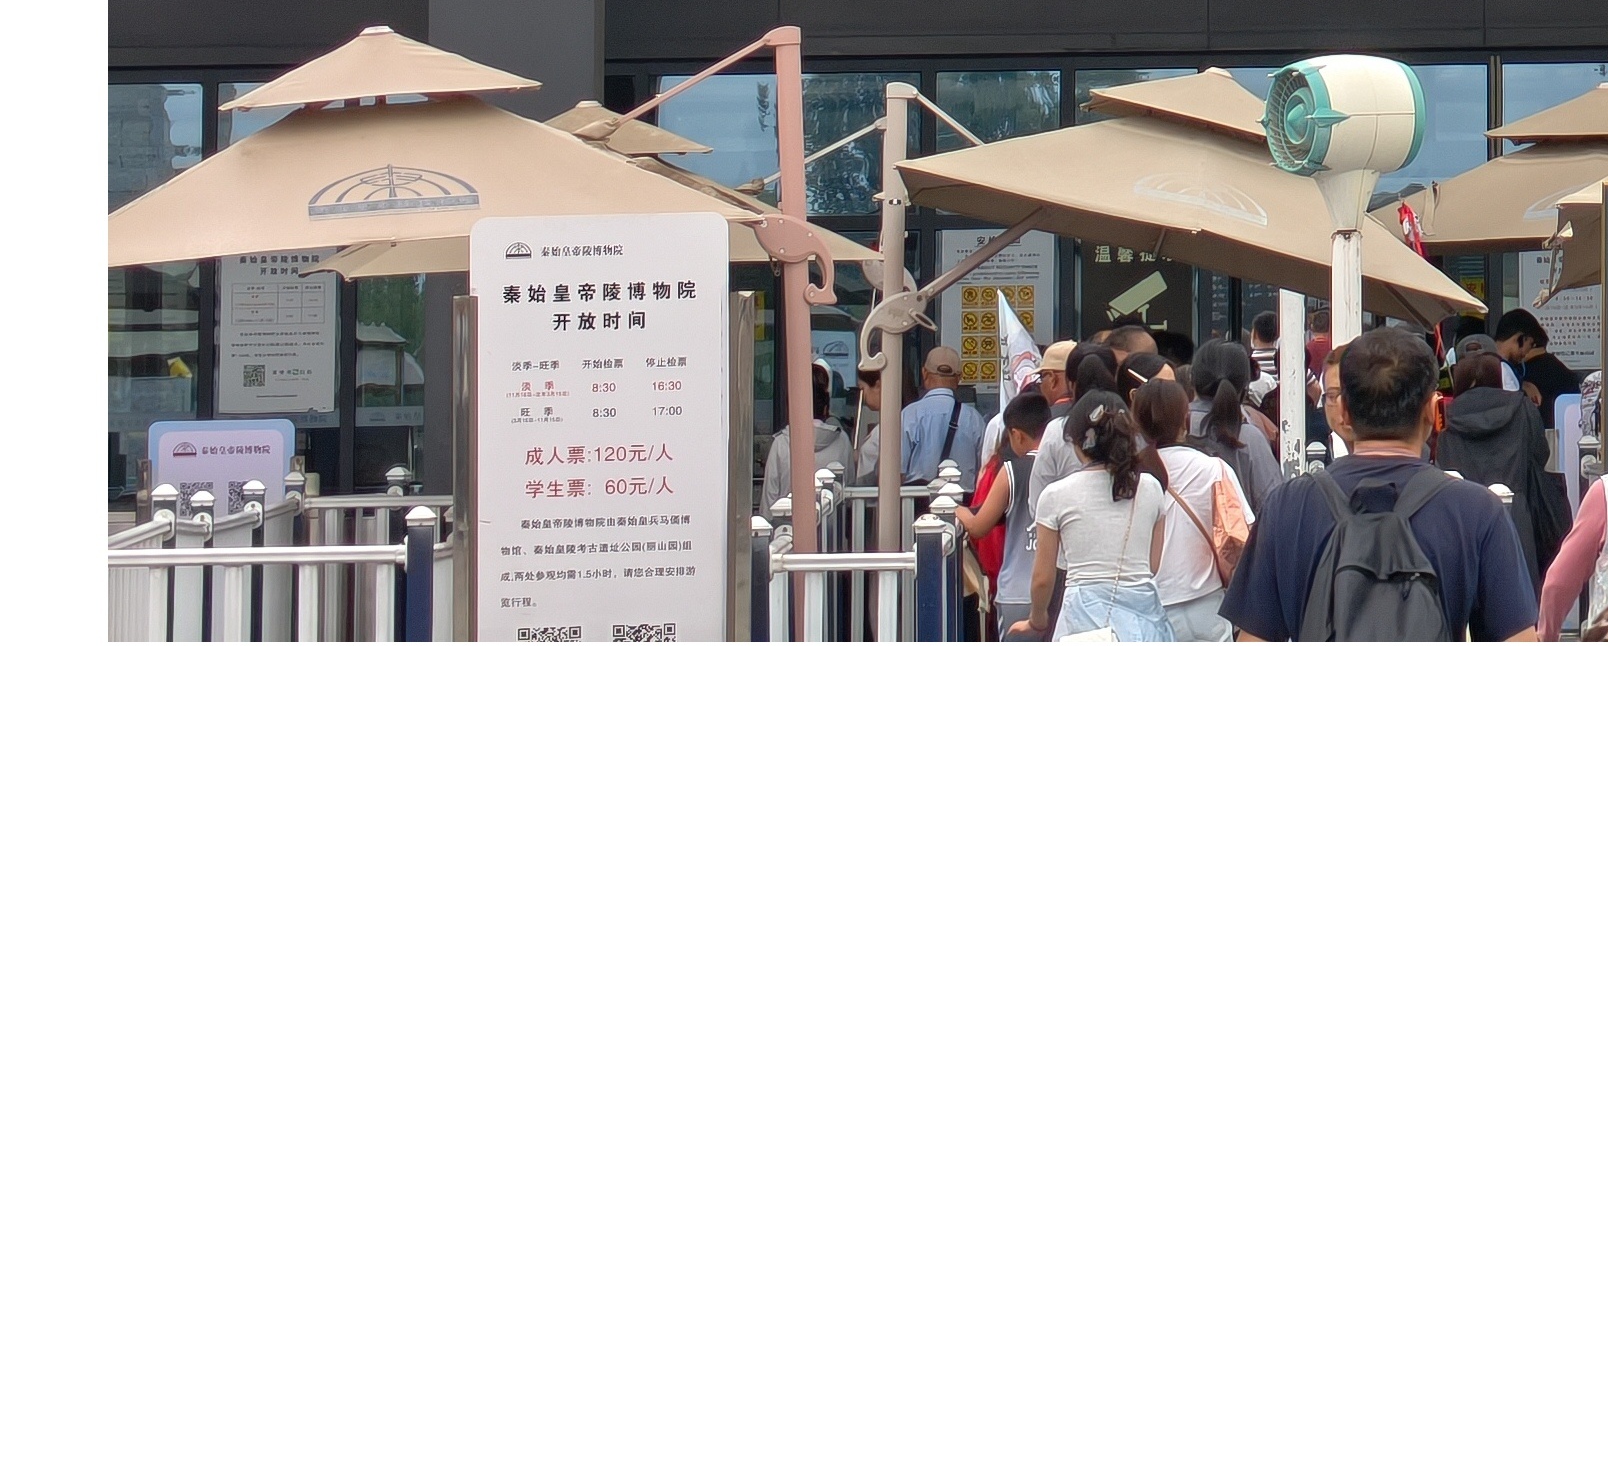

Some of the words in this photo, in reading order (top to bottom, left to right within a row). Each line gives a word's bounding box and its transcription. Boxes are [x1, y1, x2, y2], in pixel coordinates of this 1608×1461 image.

[541, 244, 624, 257] 秦始皇帝陵博物院
[503, 280, 697, 304] 秦始皇帝陵博物院
[552, 311, 646, 331] 开放时间
[582, 359, 624, 369] 开始检票
[646, 357, 687, 368] 停止检票
[592, 383, 616, 392] 8:30
[652, 382, 682, 391] 16:30
[592, 408, 617, 417] 8:30
[652, 406, 682, 416] 17:00
[501, 598, 537, 608] 览行程。
